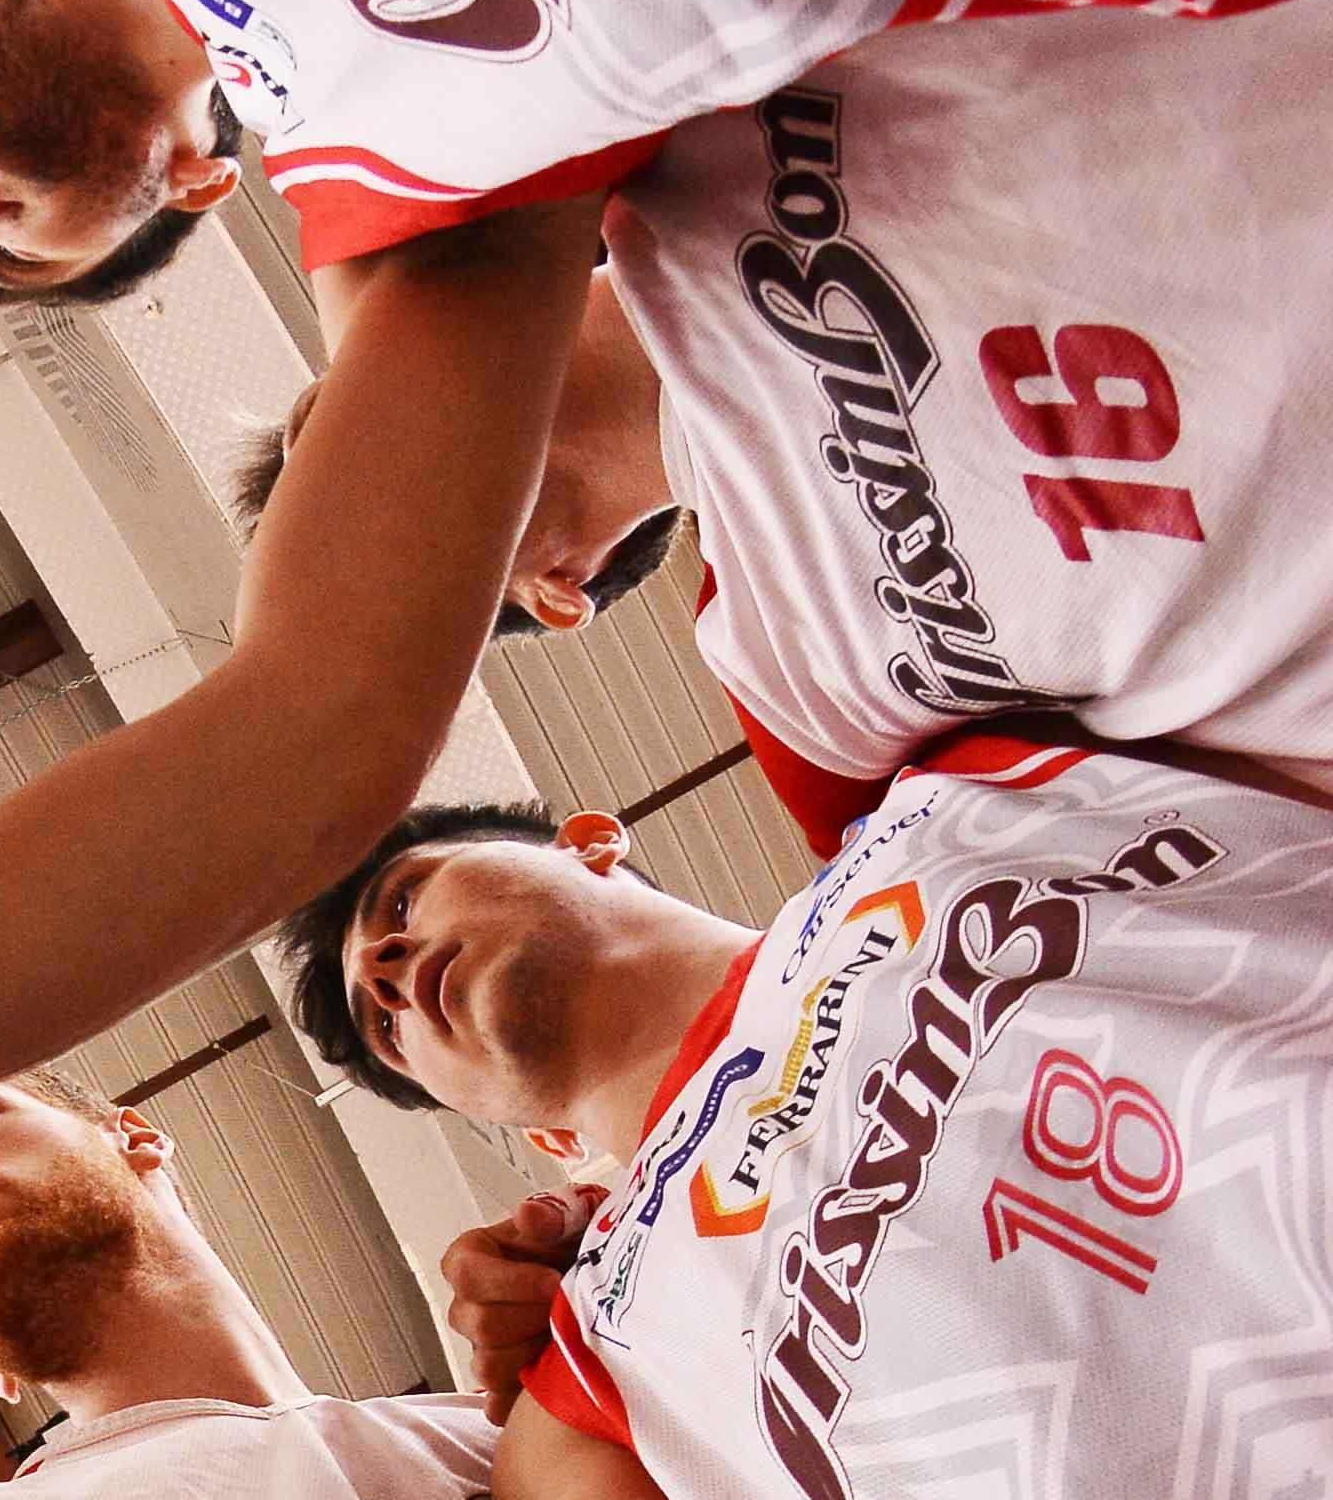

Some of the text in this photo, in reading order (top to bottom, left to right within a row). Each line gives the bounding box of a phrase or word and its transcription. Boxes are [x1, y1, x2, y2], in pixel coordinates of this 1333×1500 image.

[979, 324, 1206, 562] 16
[729, 925, 898, 1194] FERRARINI
[981, 1048, 1184, 1297] 18
